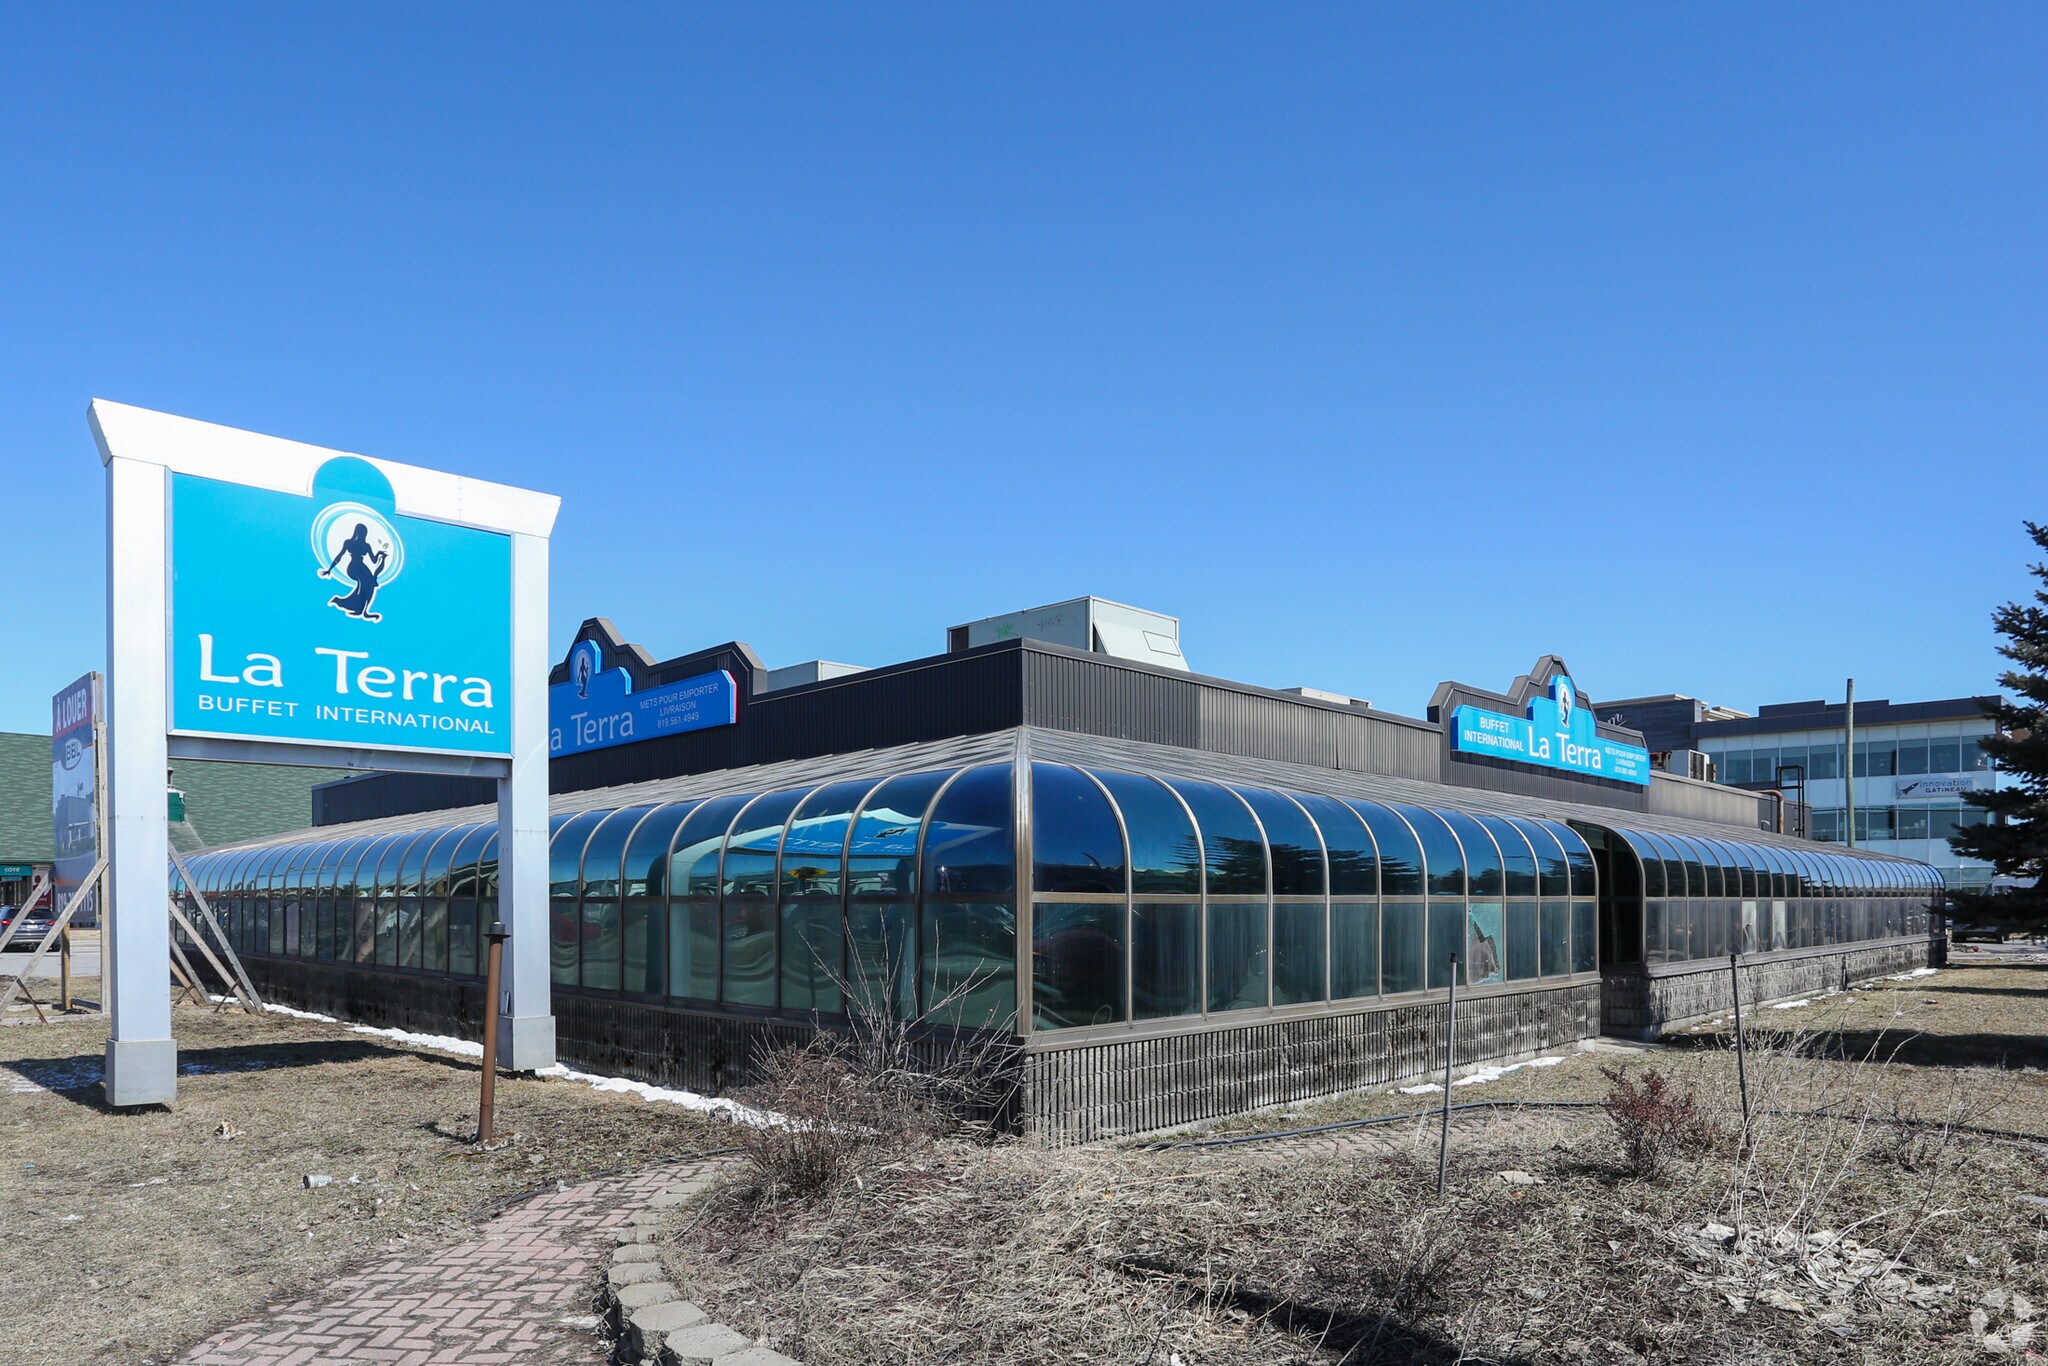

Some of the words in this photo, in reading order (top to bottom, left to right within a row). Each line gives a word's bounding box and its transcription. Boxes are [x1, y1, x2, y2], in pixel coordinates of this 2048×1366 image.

[198, 633, 284, 688] La
[314, 647, 494, 708] Terra
[62, 687, 87, 729] LOUER
[640, 697, 658, 709] METS
[659, 692, 678, 704] POUR
[679, 682, 719, 700] EMPORTER
[198, 694, 299, 717] BUFFET
[316, 704, 495, 735] INTERNATIONAL
[657, 711, 699, 729] 819.561.4949
[660, 700, 697, 717] LIVRAISON
[549, 727, 562, 751] a
[570, 711, 634, 746] Terra
[1480, 716, 1509, 733] BUFFET
[65, 741, 81, 762] BBL
[1464, 729, 1524, 752] INTERNATIONAL
[1528, 725, 1550, 759] La
[1556, 732, 1601, 769] Terra
[1920, 780, 1972, 788] innovation
